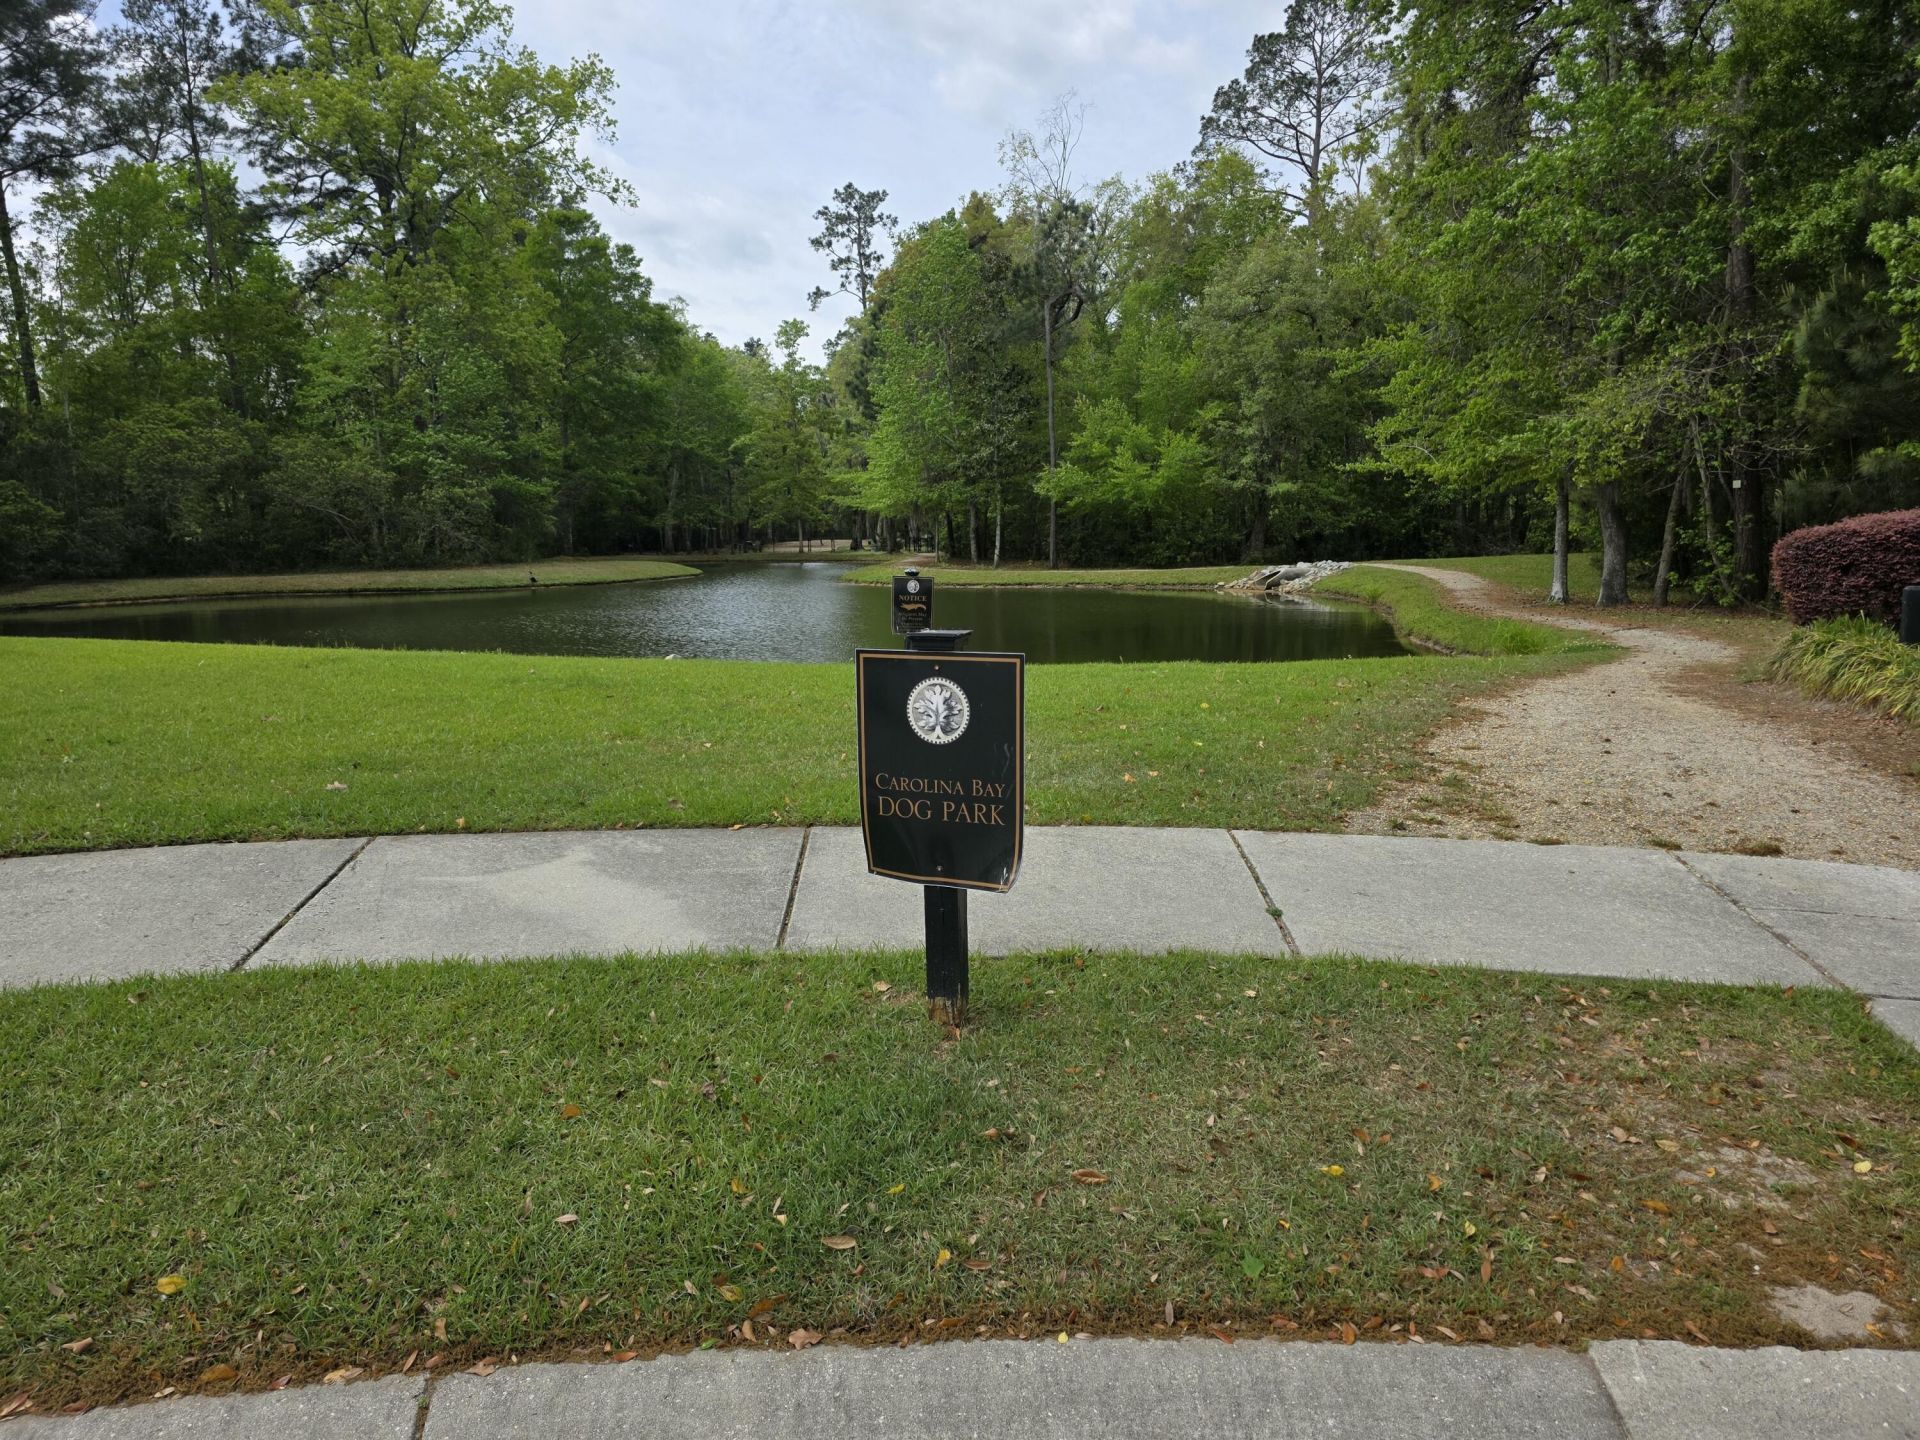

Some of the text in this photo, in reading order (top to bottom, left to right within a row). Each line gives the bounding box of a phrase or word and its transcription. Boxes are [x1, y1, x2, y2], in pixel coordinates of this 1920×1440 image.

[898, 594, 928, 602] NOTICE
[875, 772, 1006, 798] CAROLINA BAY
[878, 795, 1006, 826] DOG PARK
